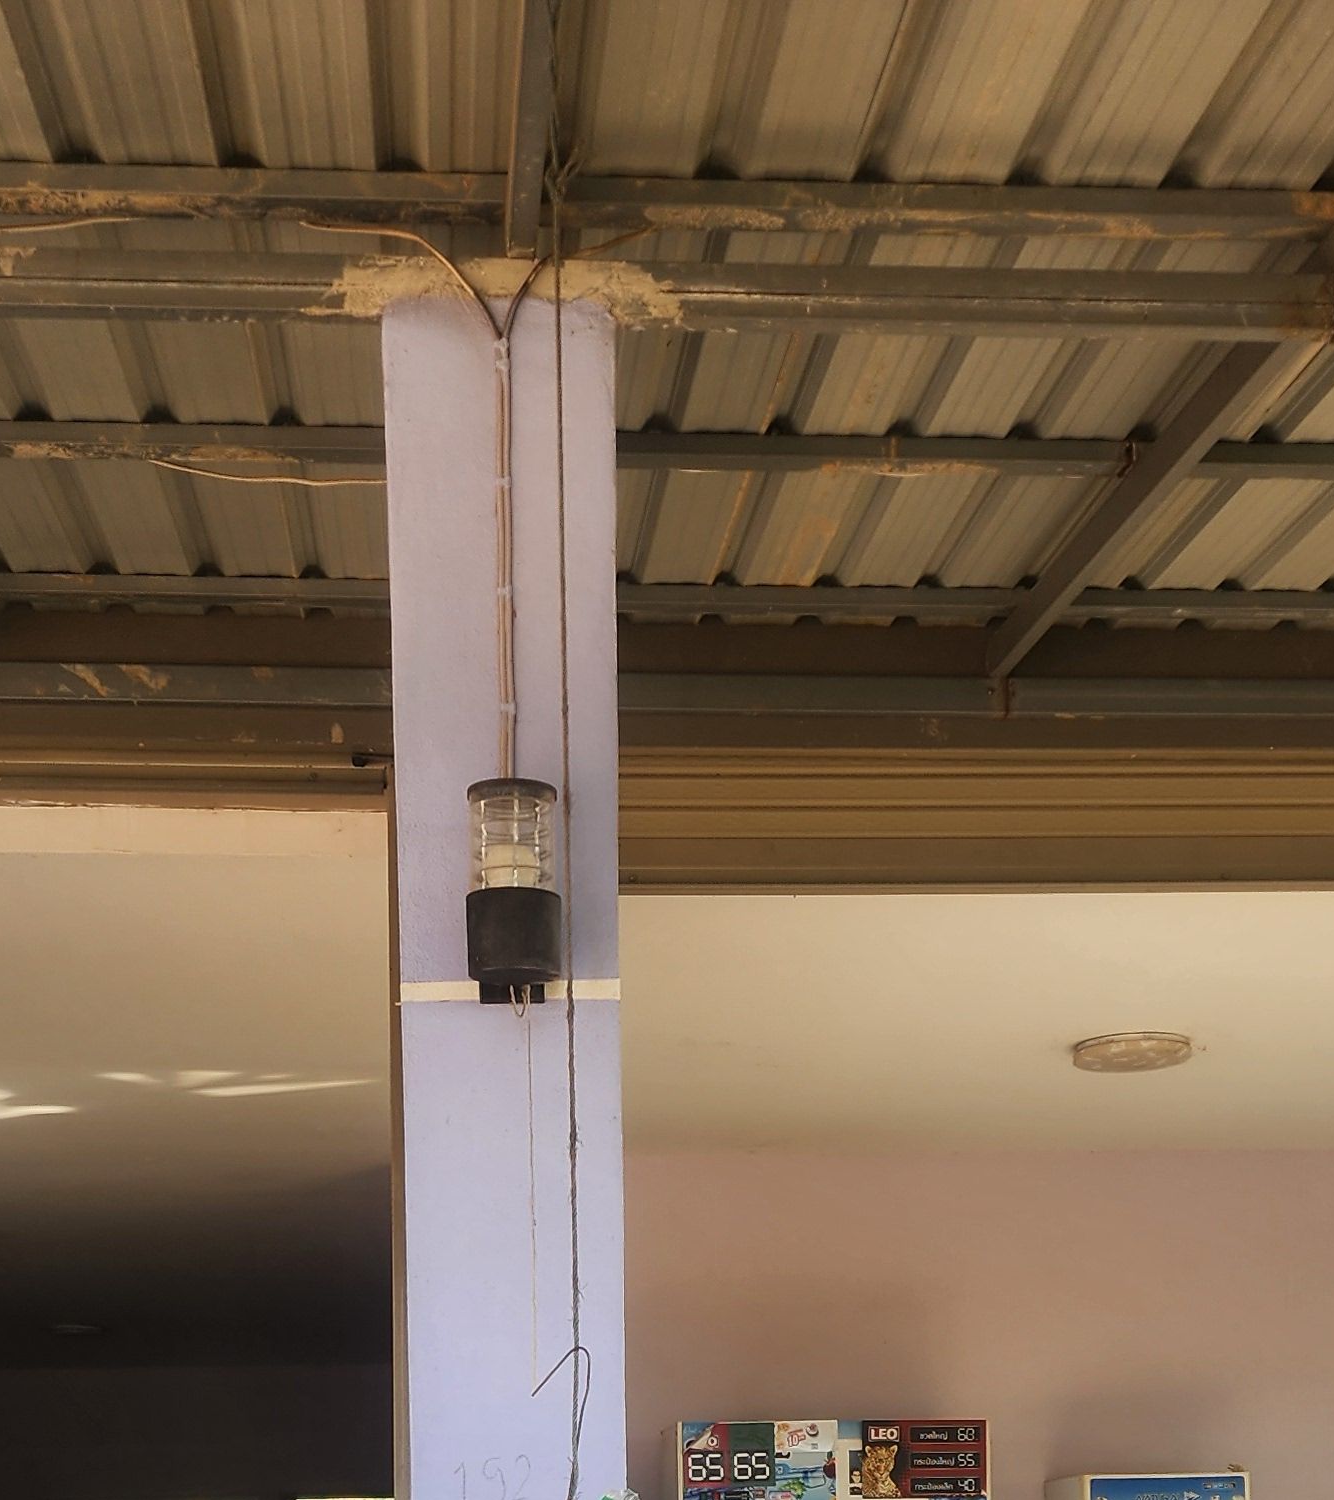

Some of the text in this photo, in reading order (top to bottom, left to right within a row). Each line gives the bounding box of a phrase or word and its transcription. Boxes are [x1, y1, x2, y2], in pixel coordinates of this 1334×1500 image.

[870, 1428, 898, 1440] LEO
[687, 1452, 770, 1482] 65 65
[957, 1479, 976, 1492] 40
